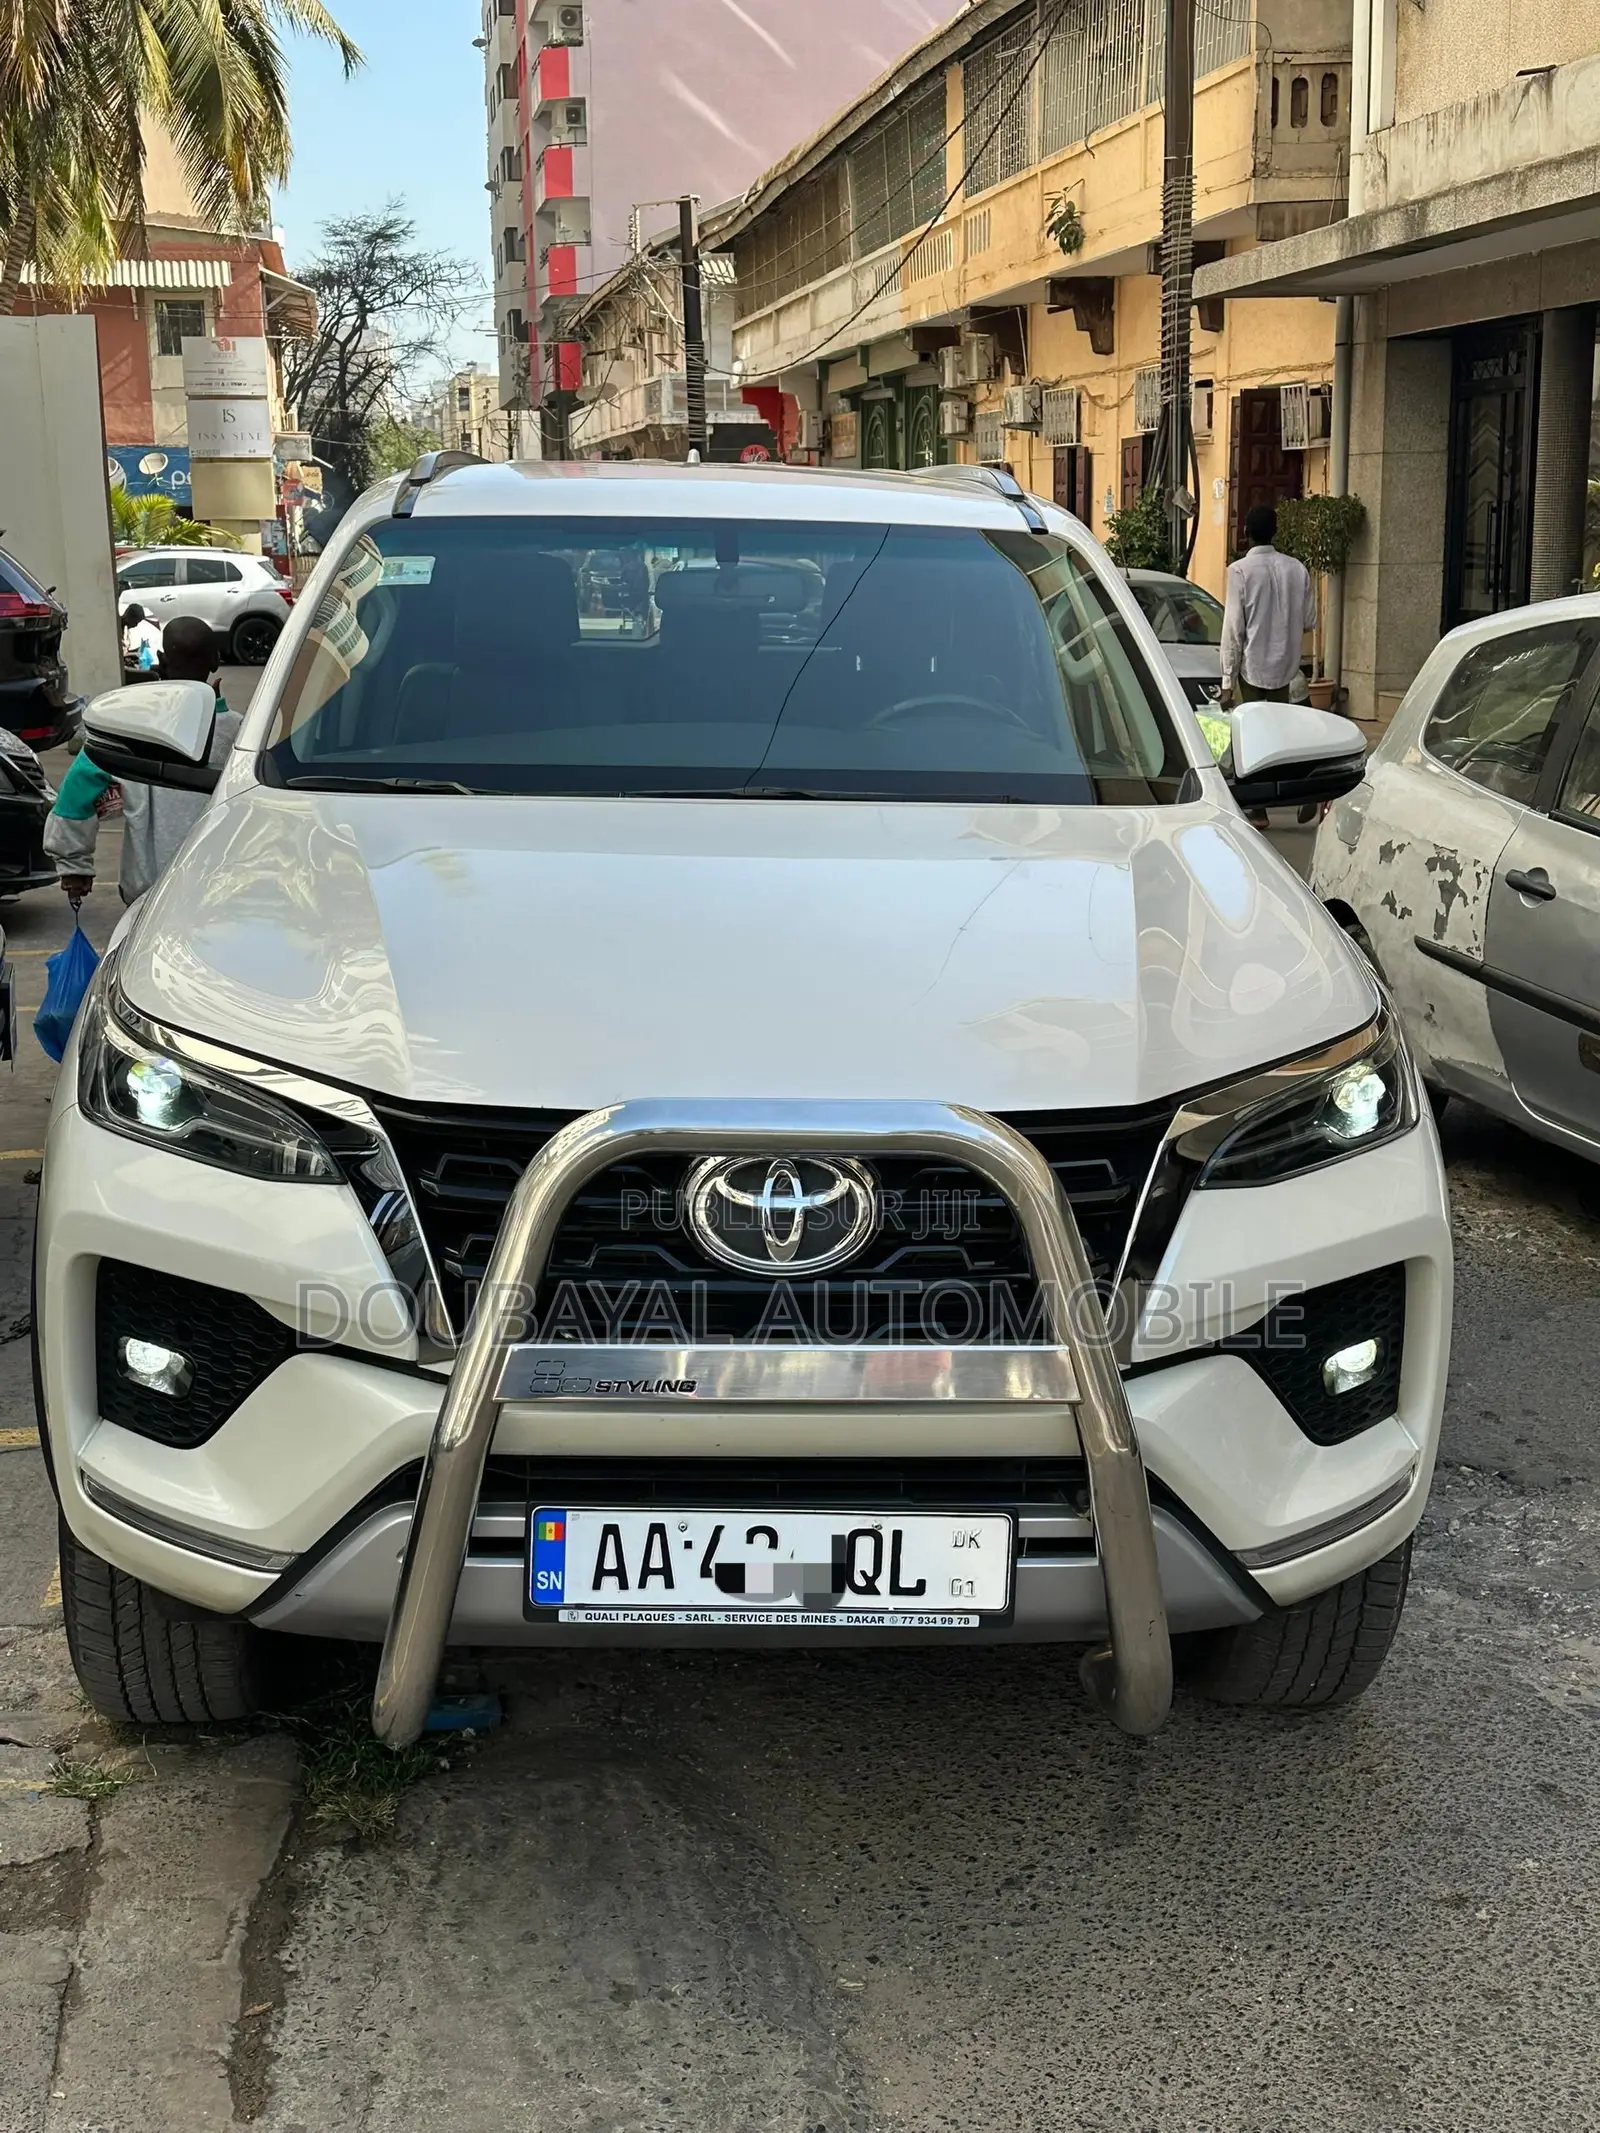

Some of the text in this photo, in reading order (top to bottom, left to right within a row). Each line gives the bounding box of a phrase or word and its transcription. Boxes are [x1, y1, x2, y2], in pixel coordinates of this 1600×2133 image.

[594, 1379, 699, 1394] STYLING
[953, 1529, 983, 1549] DK
[536, 1570, 563, 1590] SN
[584, 1612, 619, 1622] QUALI
[622, 1613, 675, 1623] PLAQUES
[685, 1614, 715, 1623] SARL
[724, 1614, 773, 1623] SERVICE
[775, 1614, 798, 1623] DES
[801, 1614, 837, 1624] MINES
[846, 1615, 885, 1625] DAKAR
[901, 1616, 914, 1625] 77
[917, 1616, 937, 1625] 934
[957, 1616, 970, 1626] 78
